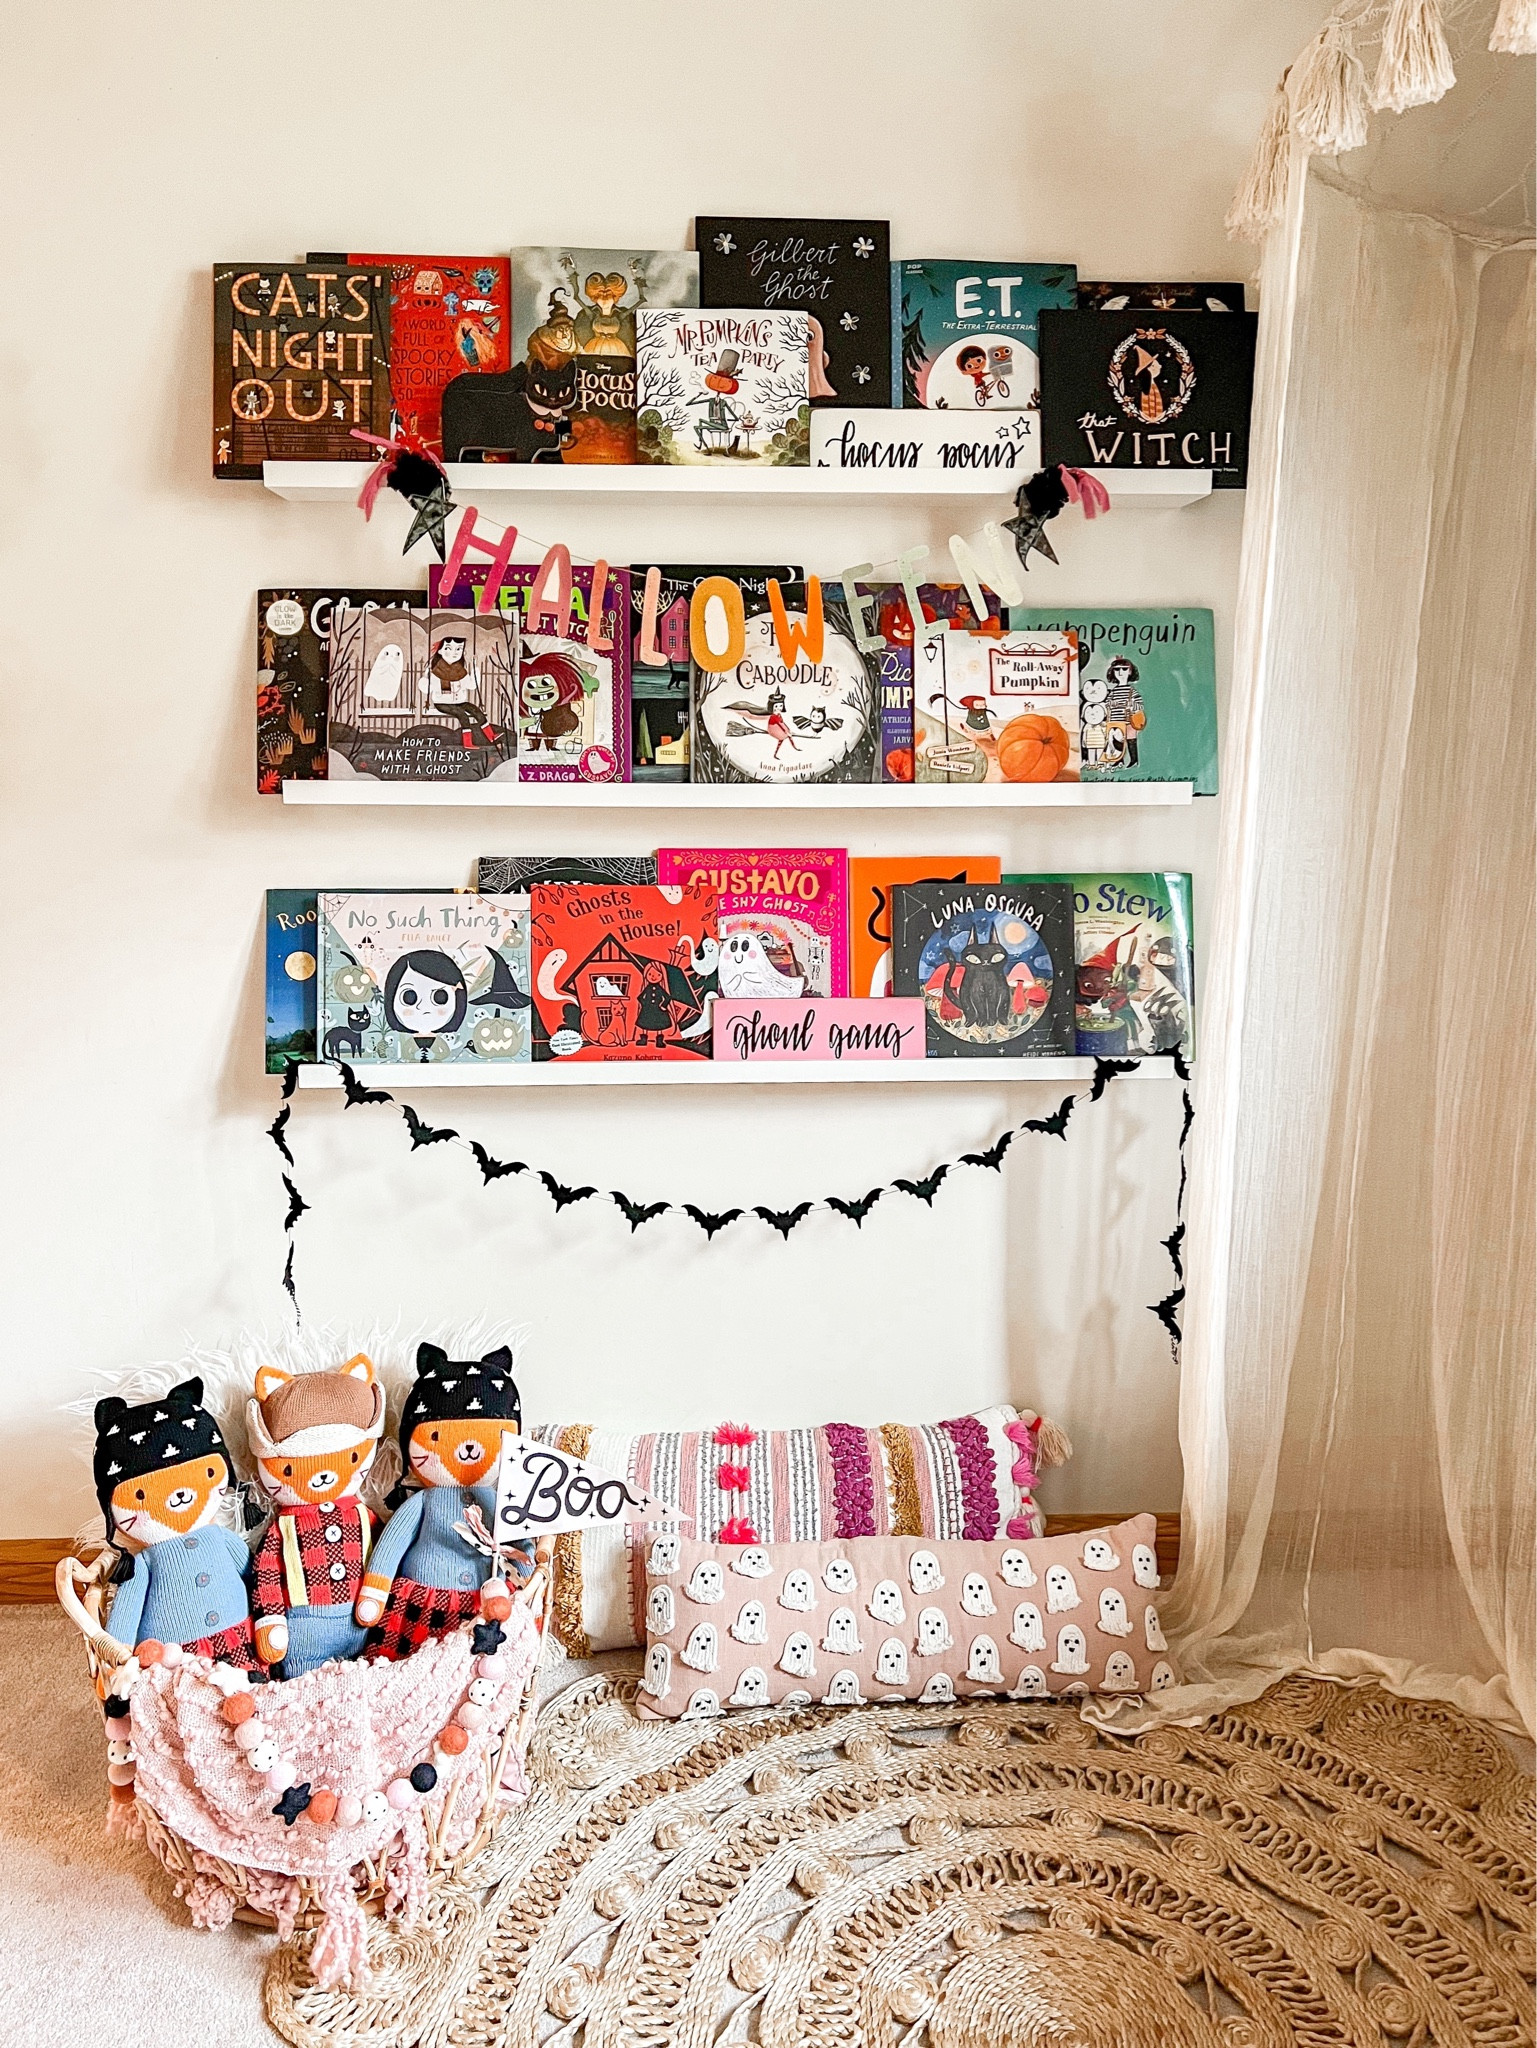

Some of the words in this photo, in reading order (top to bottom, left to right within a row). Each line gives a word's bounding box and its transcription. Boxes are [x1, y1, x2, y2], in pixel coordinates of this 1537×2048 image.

[747, 238, 840, 276] Gilbert
[797, 264, 820, 281] the
[231, 272, 382, 322] CATS'
[760, 270, 834, 307] Ghost
[955, 276, 1023, 319] E.T.
[408, 319, 446, 331] WORLD
[232, 329, 374, 372] NIGHT
[403, 332, 429, 347] FULL
[393, 349, 456, 366] SPOOKY
[690, 352, 718, 368] TEA
[741, 349, 784, 373] PARTY
[395, 367, 454, 386] STORIES
[231, 378, 373, 422] OUT
[398, 387, 413, 401] 50
[577, 389, 635, 413] POCU
[1077, 411, 1118, 430] that
[825, 420, 924, 468] hocus
[1085, 431, 1232, 466] WITCH
[438, 505, 1024, 674] HALLOWEEN
[666, 579, 689, 592] The
[739, 577, 769, 594] Nig
[736, 660, 833, 690] CABOODLE
[995, 657, 1010, 667] The
[1013, 661, 1064, 677] Roll-Away
[1000, 675, 1060, 693] Pumpkin
[428, 736, 441, 747] TO
[374, 749, 411, 762] MAKE
[416, 749, 471, 762] FRIENDS
[381, 764, 411, 774] WITH
[415, 763, 423, 774] A
[426, 763, 463, 775] GHOST
[527, 771, 538, 782] Z.
[539, 771, 576, 782] DRAGO
[566, 889, 632, 918] Ghosts
[732, 896, 758, 908] SHY
[762, 896, 809, 914] GHOST
[930, 896, 975, 930] LUNA
[984, 892, 1046, 932] OSCURA
[1095, 883, 1173, 923] Stew
[275, 910, 317, 932] Roo
[348, 909, 378, 929] No
[386, 905, 433, 929] Such
[439, 907, 502, 938] Thing
[599, 913, 616, 925] in
[618, 907, 644, 920] the
[617, 920, 682, 943] House!
[725, 1008, 817, 1060] ghoul
[828, 1022, 915, 1060] gang
[500, 1451, 639, 1526] Boo
